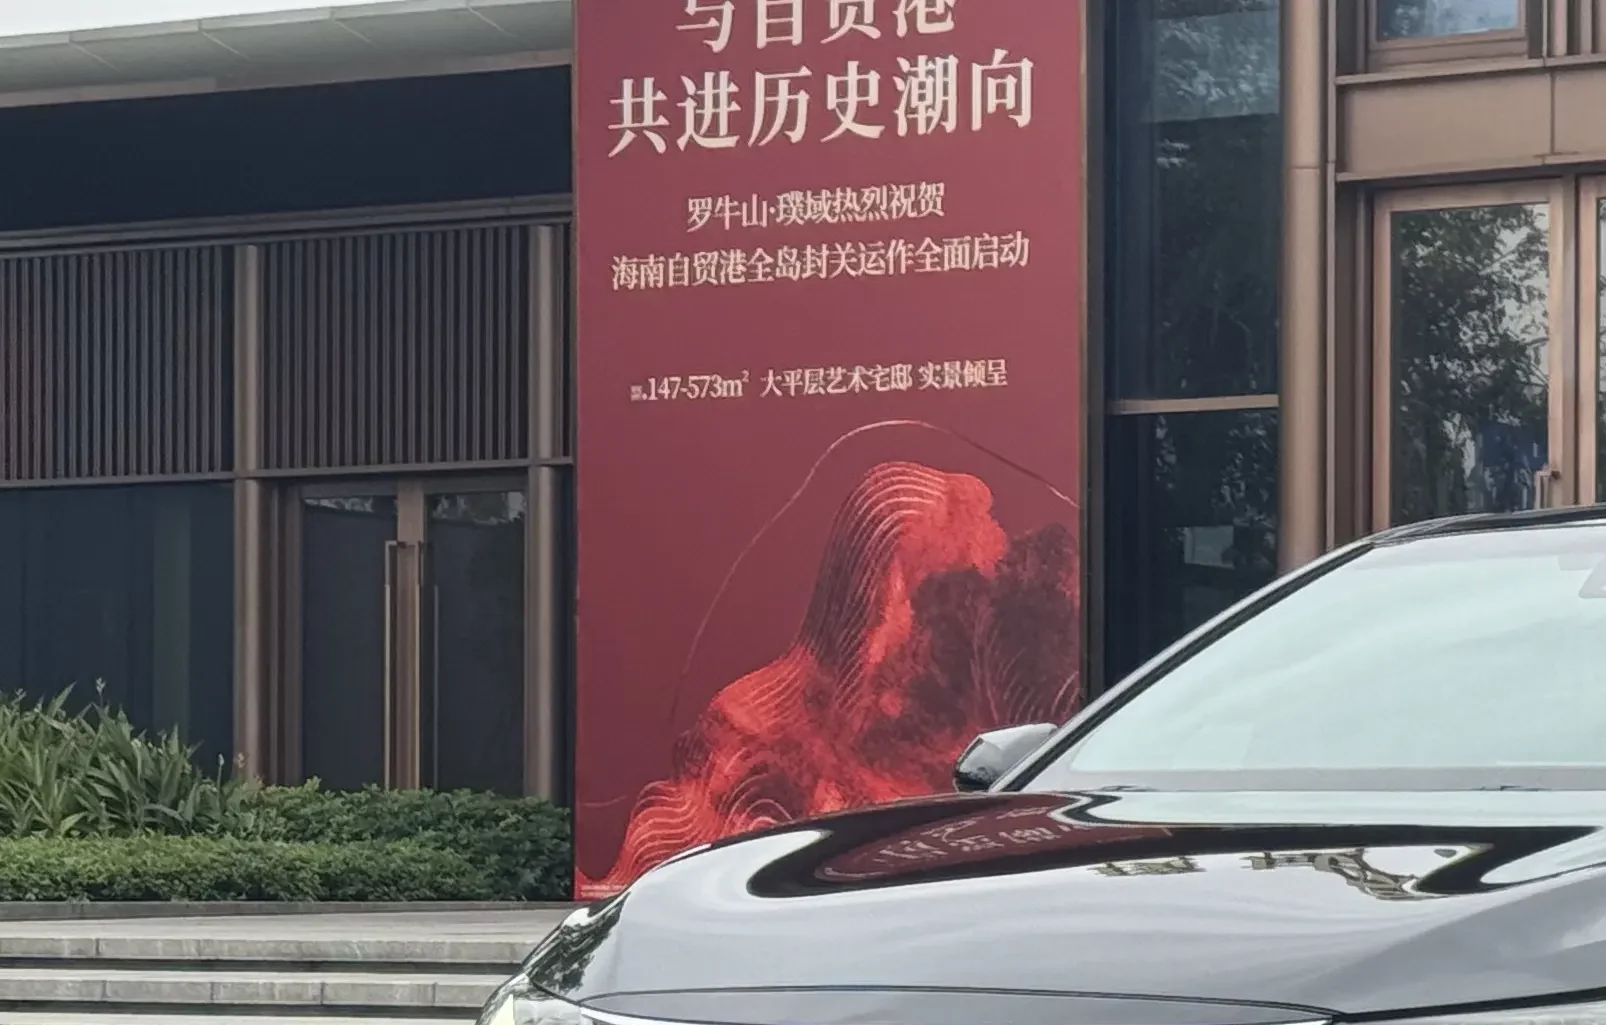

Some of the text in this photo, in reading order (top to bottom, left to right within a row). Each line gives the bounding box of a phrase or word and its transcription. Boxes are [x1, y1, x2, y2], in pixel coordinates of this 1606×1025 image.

[607, 48, 1034, 158] 共进历史潮向
[611, 230, 1030, 291] 海南自贸港全岛封关运作全面启动
[760, 363, 913, 398] 大平层艺术宅邸
[918, 358, 1008, 391] 实景倾呈
